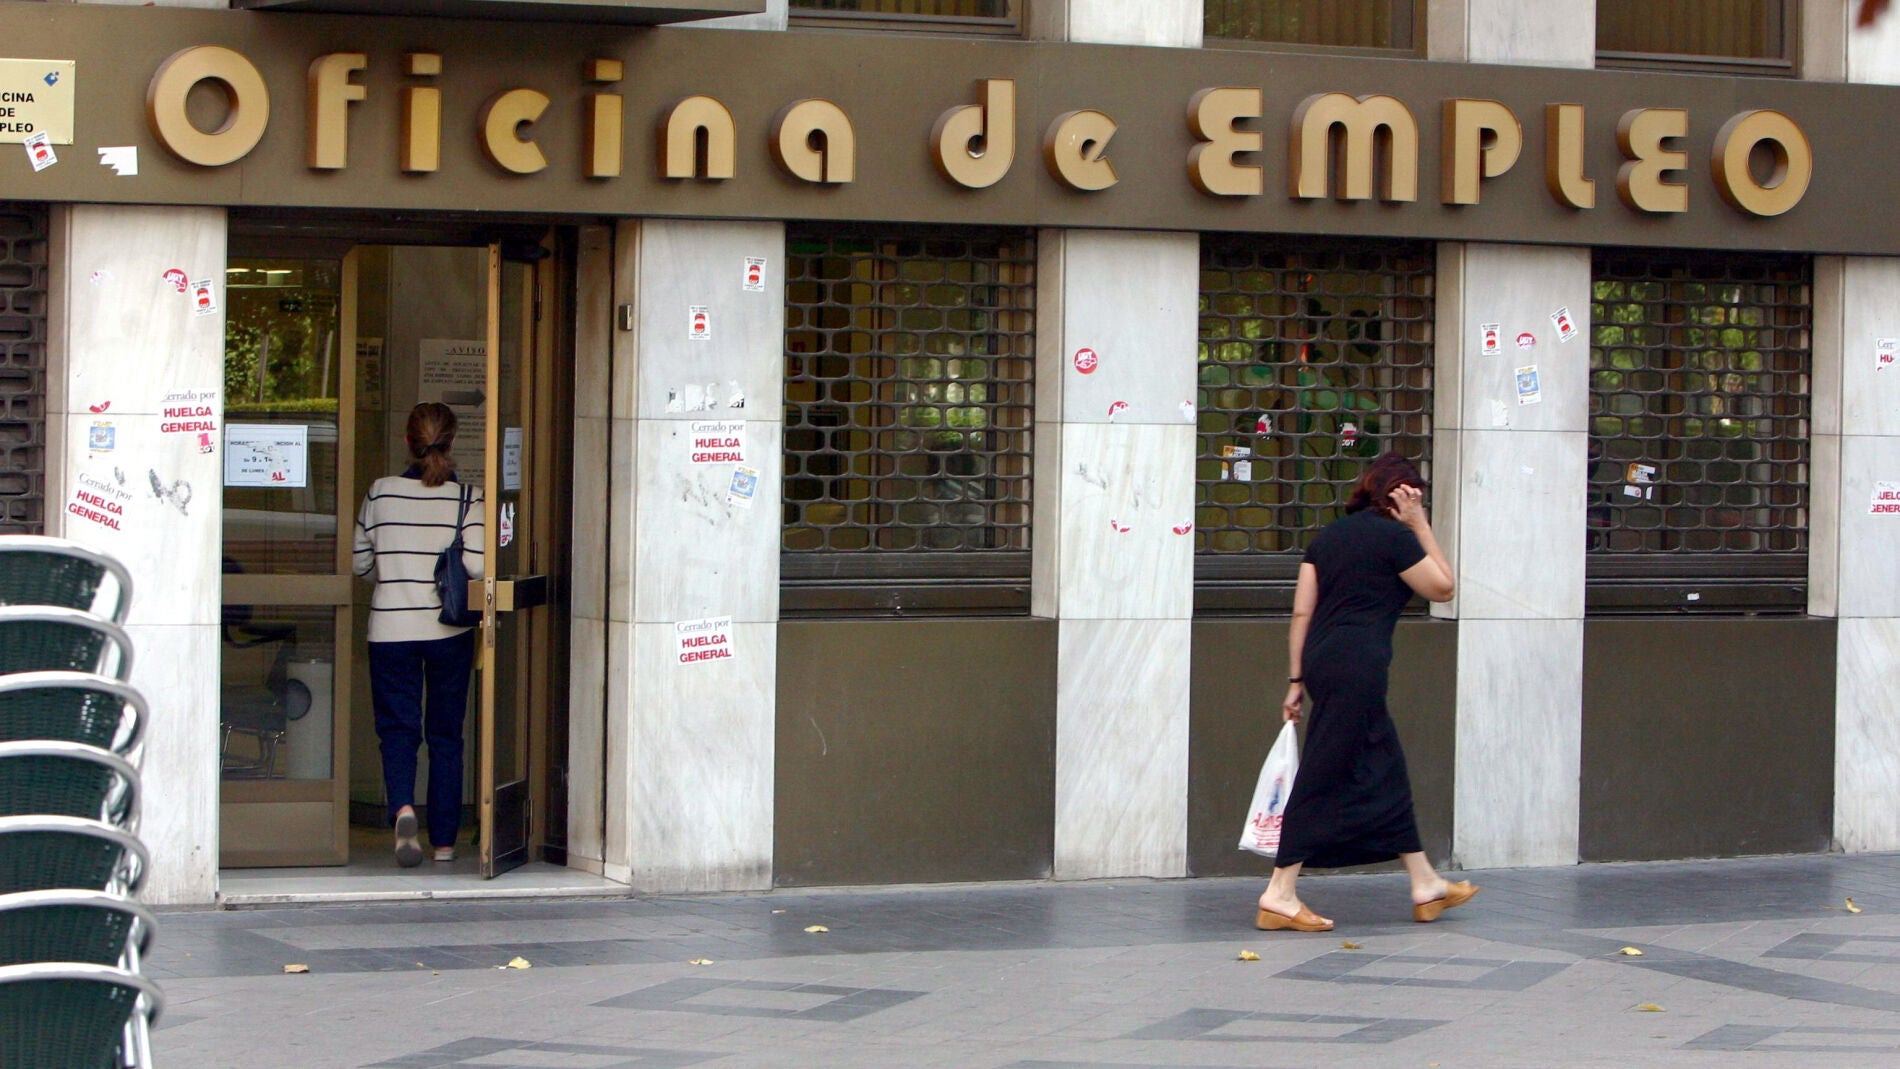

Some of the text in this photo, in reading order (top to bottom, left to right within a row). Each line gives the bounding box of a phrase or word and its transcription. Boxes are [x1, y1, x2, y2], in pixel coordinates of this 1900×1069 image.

[147, 44, 1812, 216] Oficina de EMPLEO
[199, 392, 216, 403] por
[163, 406, 213, 418] HUELGA
[160, 421, 217, 433] GENERAL
[691, 421, 744, 434] Cerrado por
[695, 437, 741, 448] HUELGA
[691, 451, 744, 462] GENERAL
[79, 472, 133, 501] Cerrado por
[76, 489, 123, 516] HUELGA
[68, 502, 121, 531] GENERAL
[677, 619, 730, 633] Cerrado por
[682, 633, 728, 648] HUELGA
[679, 647, 732, 663] GENERAL
